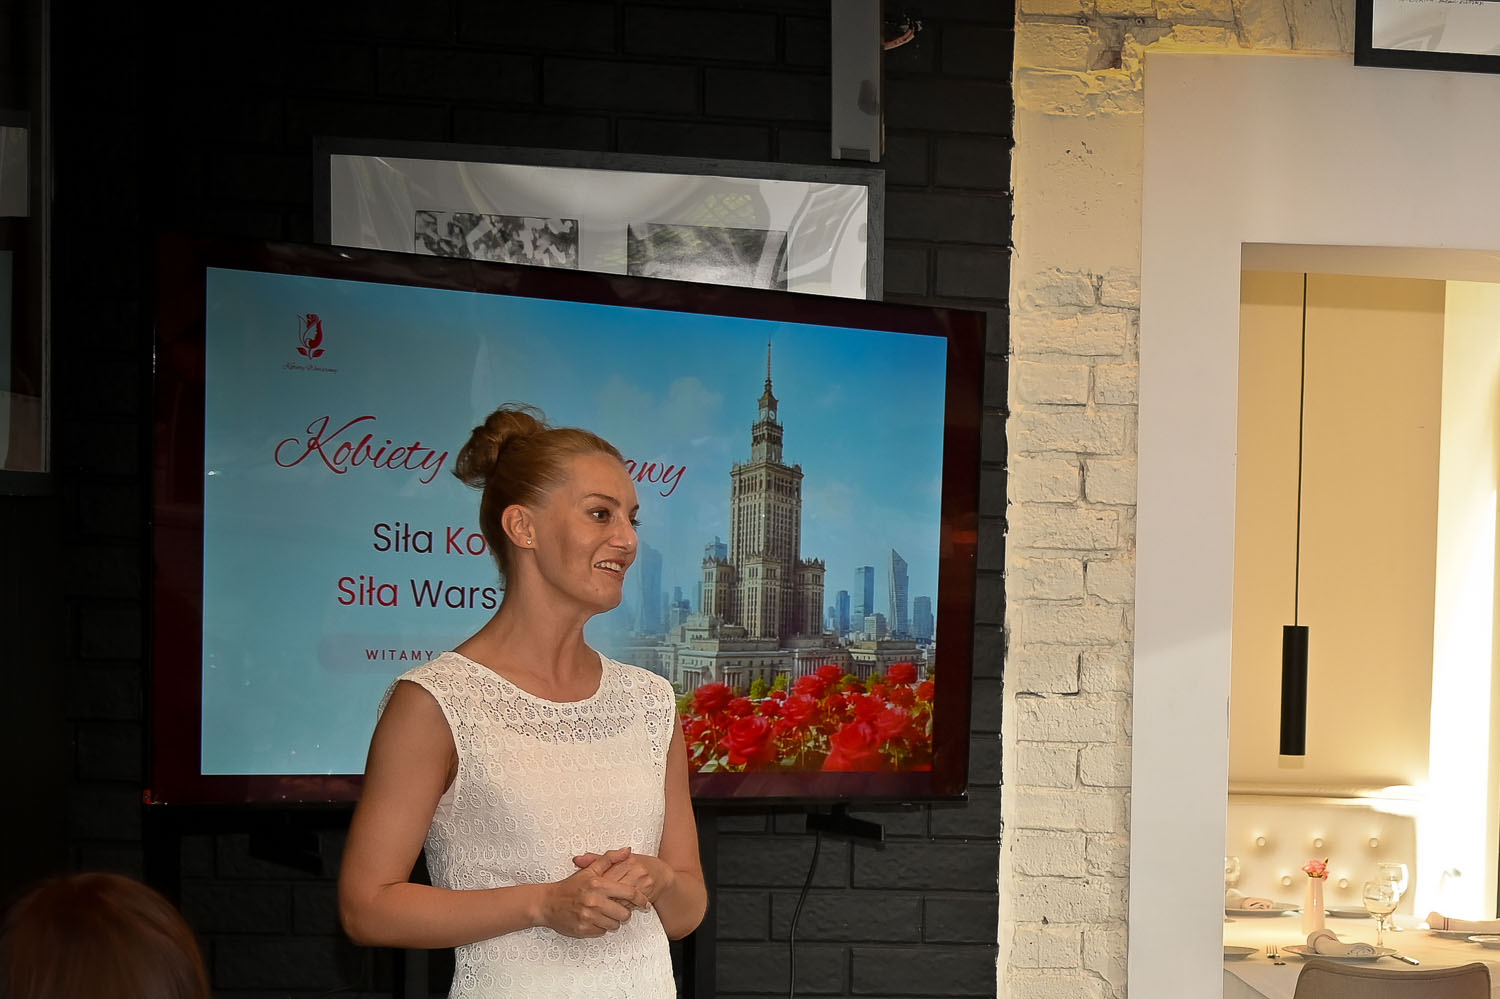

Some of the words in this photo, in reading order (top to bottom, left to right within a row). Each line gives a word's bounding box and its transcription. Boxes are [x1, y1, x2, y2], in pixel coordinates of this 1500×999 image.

[274, 415, 449, 484] Kobiety
[624, 459, 687, 497] awy
[373, 521, 433, 554] Siła
[446, 526, 488, 556] Ko
[337, 576, 399, 607] Siła
[410, 578, 498, 610] Wars
[365, 648, 434, 661] WITAMY
